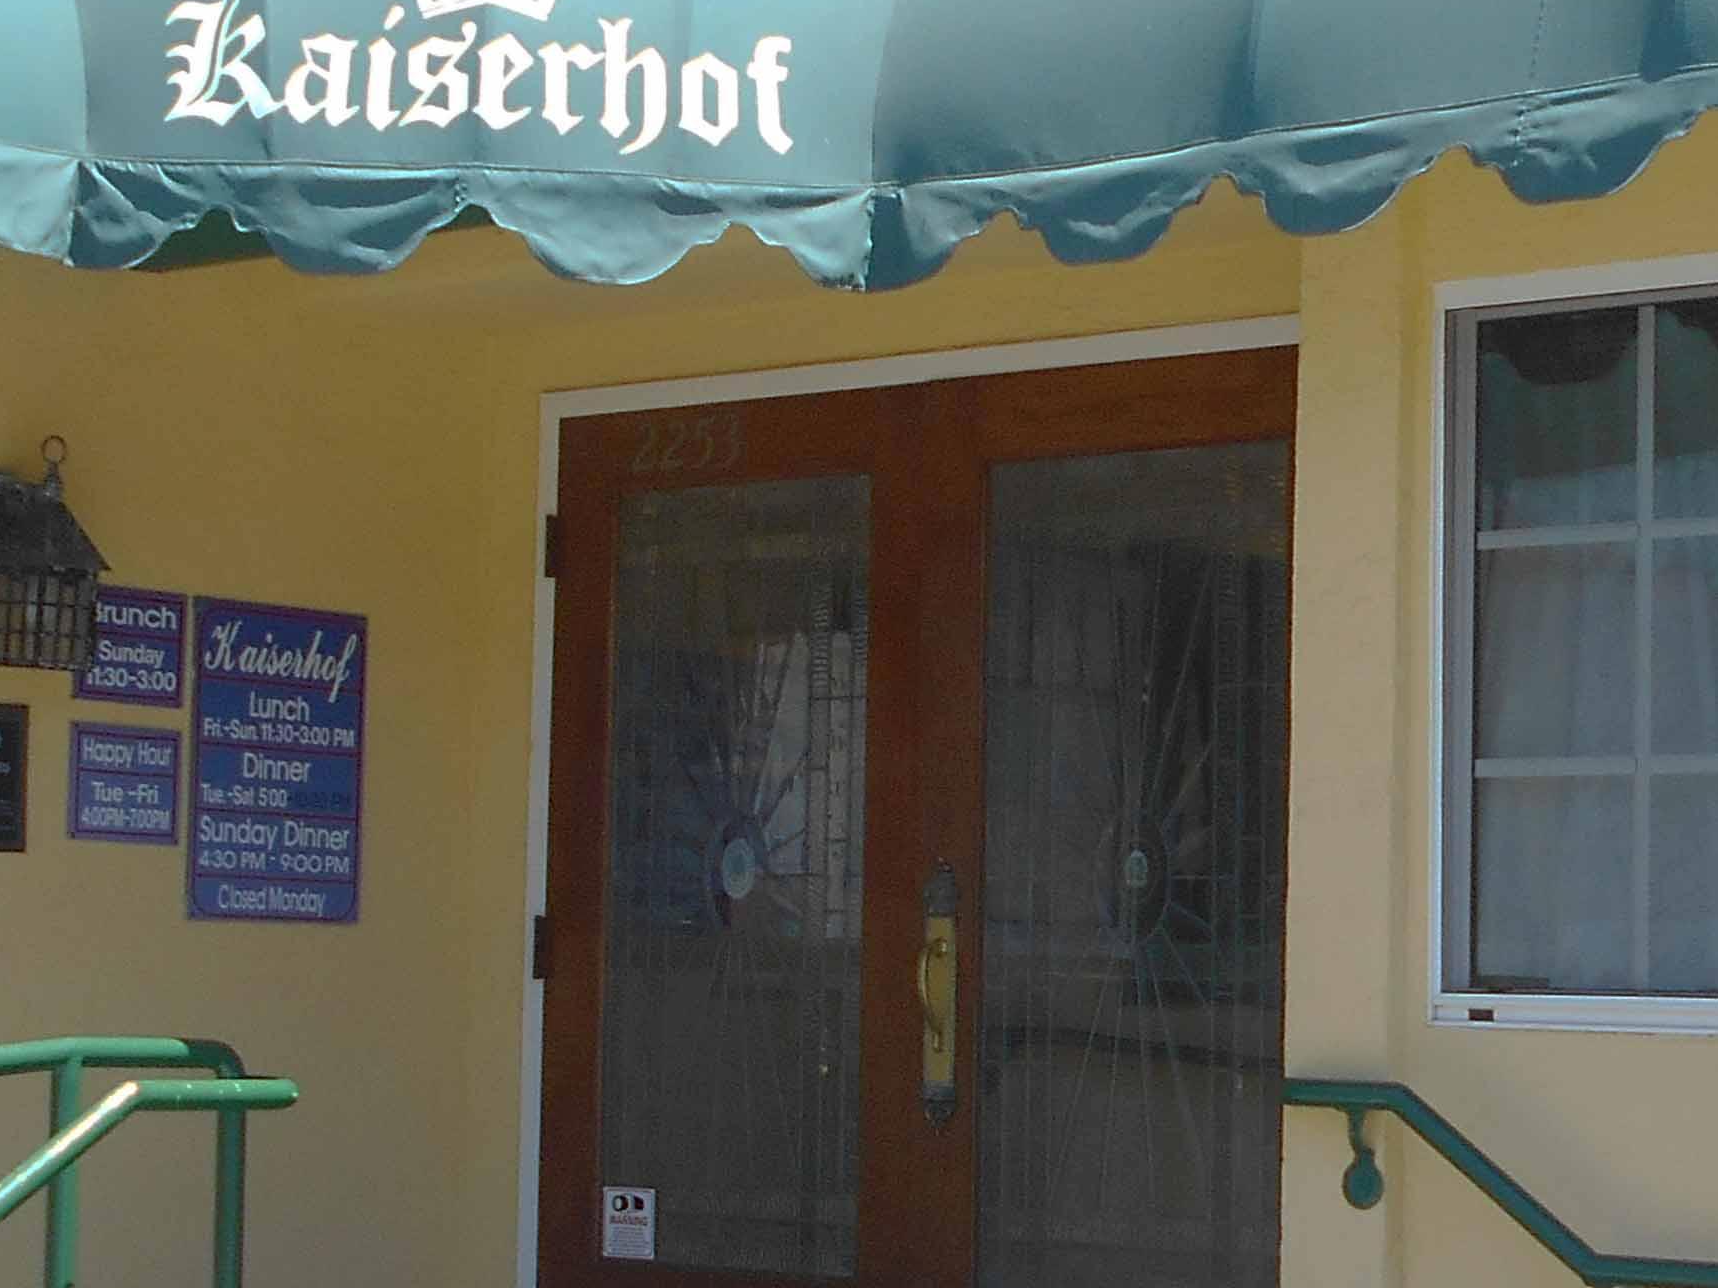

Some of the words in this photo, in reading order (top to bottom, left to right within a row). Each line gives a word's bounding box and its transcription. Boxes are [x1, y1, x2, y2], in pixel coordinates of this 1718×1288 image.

[165, 0, 794, 154] Kaiserhof
[98, 639, 164, 669] Sunday
[204, 620, 357, 703] Kaiserhof
[249, 691, 310, 721] Lunch
[83, 737, 133, 768] Happy
[138, 741, 171, 765] Hour
[333, 728, 355, 747] PM
[242, 752, 311, 783] Dinner
[200, 816, 278, 850] Sunday
[284, 821, 349, 850] Dinner
[241, 851, 266, 871] PM
[325, 856, 349, 873] PM
[218, 884, 266, 909] Closed
[269, 886, 325, 916] Monday
